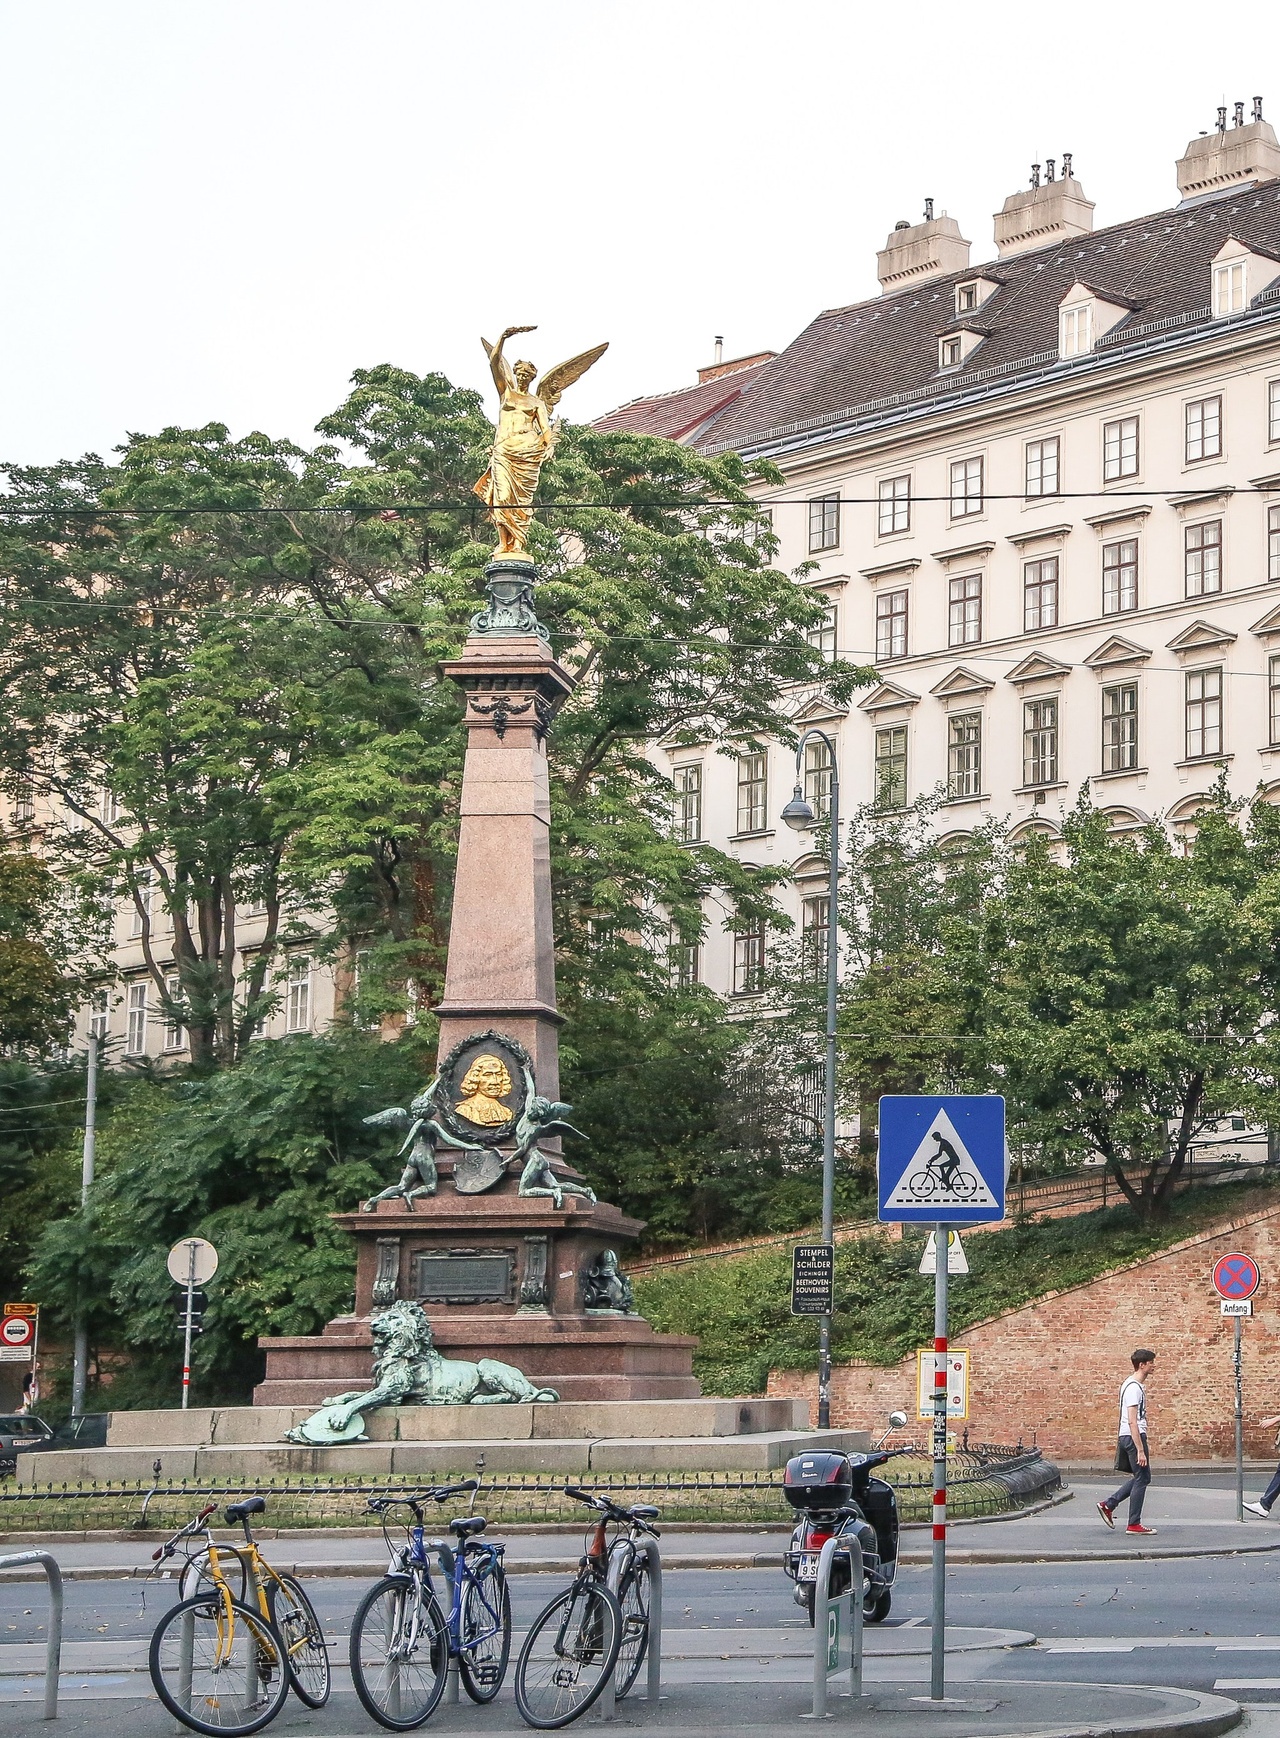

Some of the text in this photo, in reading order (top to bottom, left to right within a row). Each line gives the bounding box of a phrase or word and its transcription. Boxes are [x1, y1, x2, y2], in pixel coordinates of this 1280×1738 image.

[799, 1249, 828, 1257] STEMPEL
[1223, 1303, 1248, 1315] Anfang
[810, 1555, 818, 1565] W
[802, 1566, 808, 1576] 9
[828, 1610, 837, 1667] P
